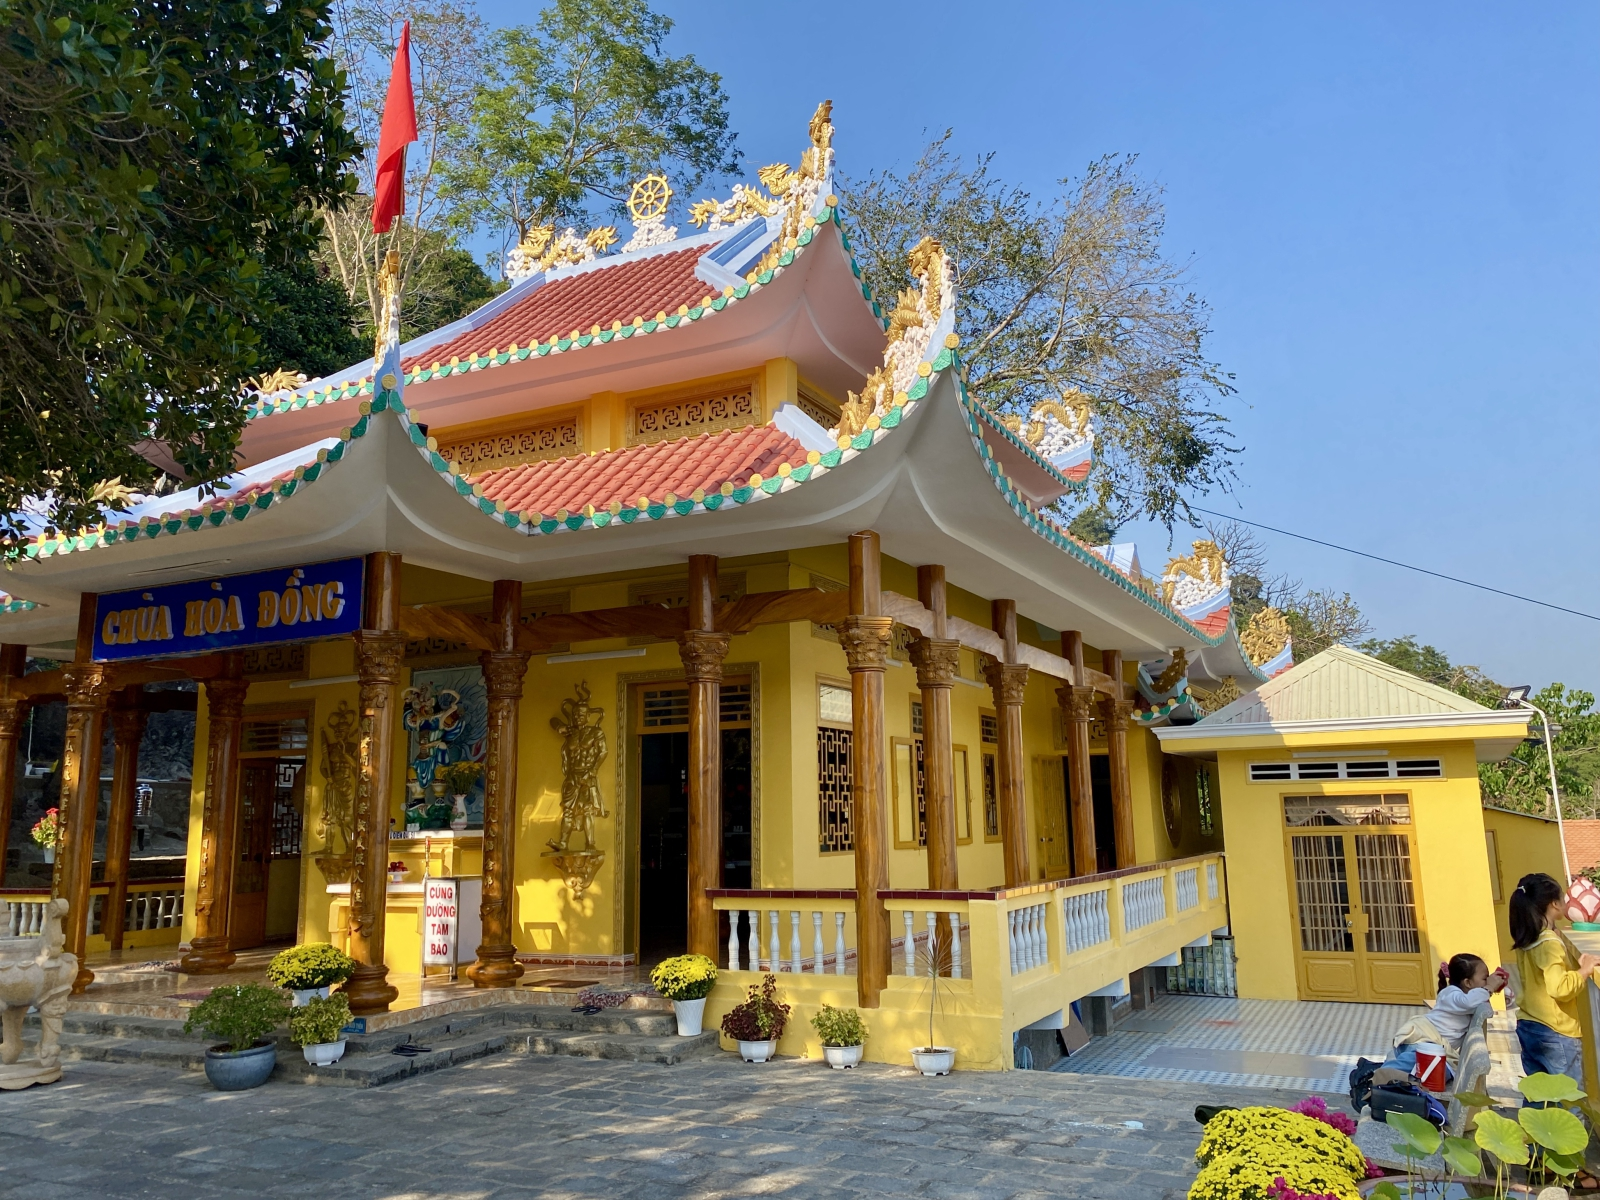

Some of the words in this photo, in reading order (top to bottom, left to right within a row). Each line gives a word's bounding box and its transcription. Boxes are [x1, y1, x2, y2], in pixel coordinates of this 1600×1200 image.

[102, 592, 174, 645] CHÙA
[184, 581, 245, 636] HÒA
[256, 569, 346, 628] ĐỒNG
[429, 884, 453, 899] CÚNG
[426, 902, 456, 918] DƯỜNG
[431, 923, 449, 936] TAM
[430, 938, 448, 956] BẢO
